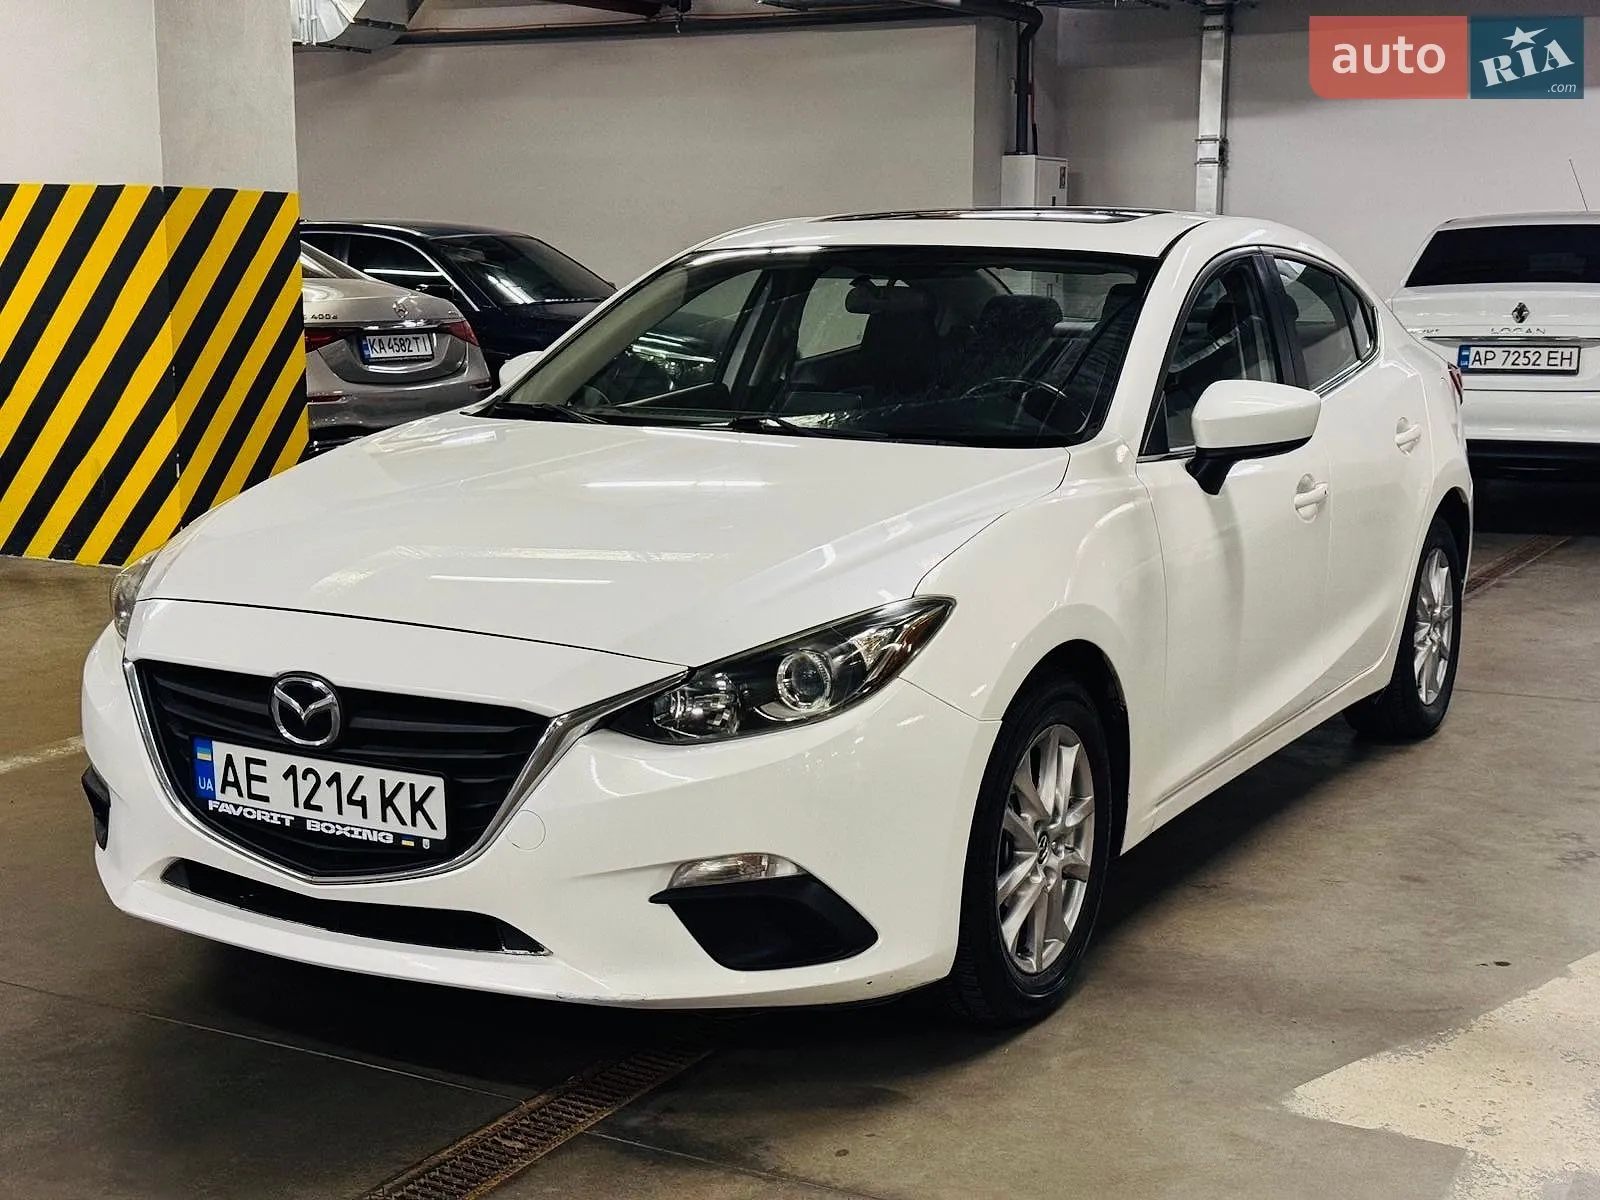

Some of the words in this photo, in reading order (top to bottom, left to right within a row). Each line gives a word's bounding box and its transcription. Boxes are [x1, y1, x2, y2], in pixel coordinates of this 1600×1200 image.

[1490, 327, 1546, 335] LOGAN
[368, 338, 387, 354] KA
[387, 337, 413, 353] 4582
[1471, 350, 1497, 367] AP
[1501, 350, 1542, 367] 7252
[1546, 350, 1573, 367] EH
[198, 776, 214, 792] UA
[219, 753, 271, 803] AE
[282, 764, 368, 820] 1214
[379, 778, 438, 831] KK
[208, 799, 295, 827] FAVORIT
[306, 819, 394, 845] BOXING
